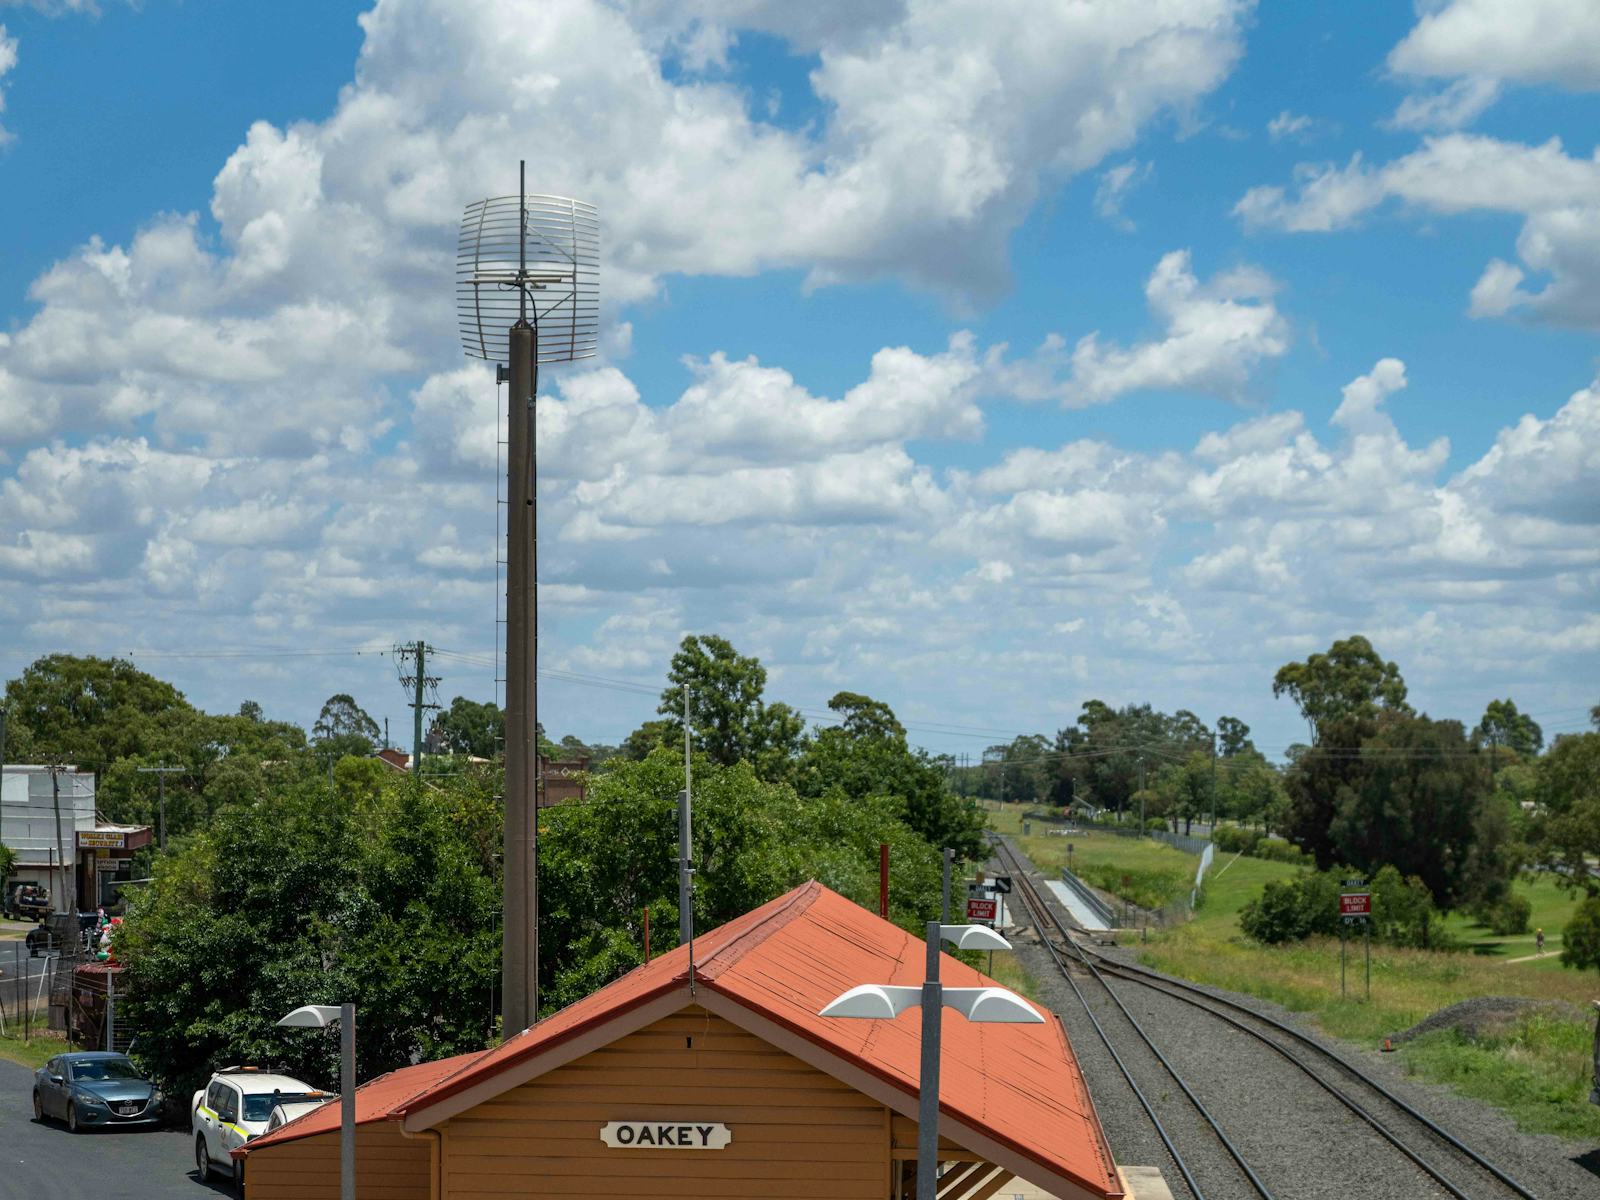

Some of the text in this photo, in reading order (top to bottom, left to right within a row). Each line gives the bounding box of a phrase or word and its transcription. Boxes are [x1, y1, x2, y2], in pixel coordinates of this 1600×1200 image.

[1344, 897, 1367, 905] BLOCK
[971, 902, 993, 911] BLOCK
[1346, 904, 1364, 912] LIMIT
[973, 910, 990, 918] LIMIT
[616, 1125, 715, 1147] OAKEY
